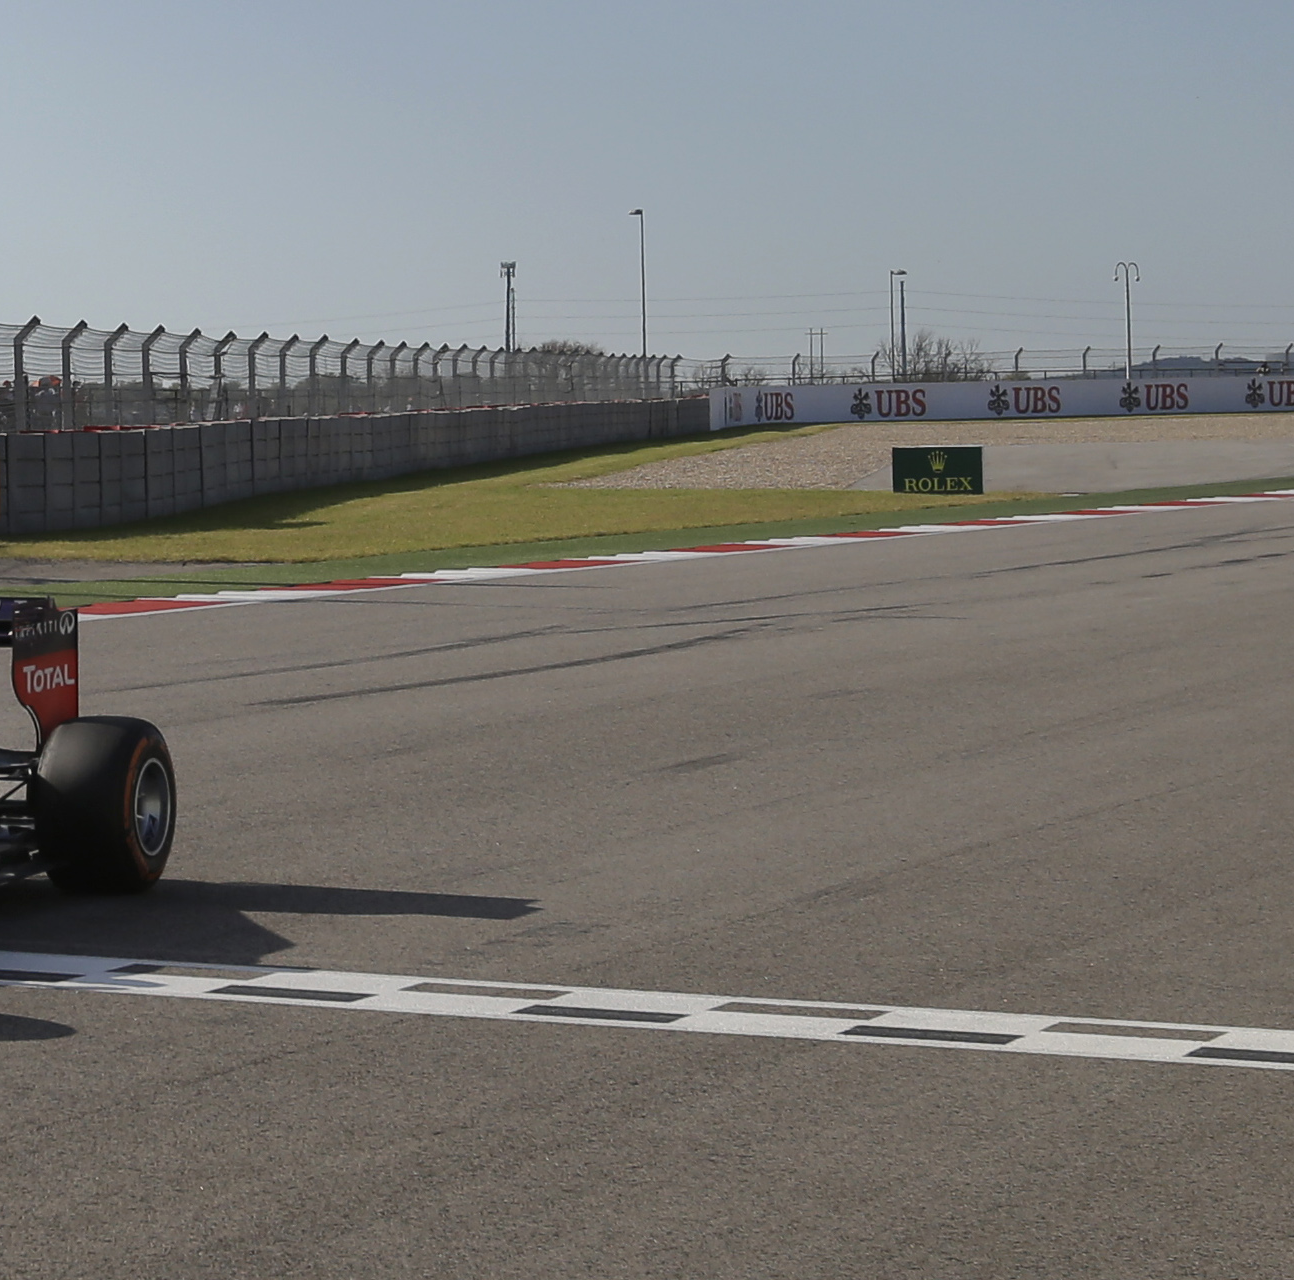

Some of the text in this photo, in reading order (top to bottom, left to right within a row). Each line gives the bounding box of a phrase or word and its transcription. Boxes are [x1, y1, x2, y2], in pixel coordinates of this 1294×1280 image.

[763, 392, 794, 420] UBS
[875, 389, 927, 417] UBS
[1012, 386, 1061, 414] UBS
[1145, 383, 1189, 410] UBS
[904, 477, 973, 492] ROLEX
[23, 664, 75, 694] TOTAL
